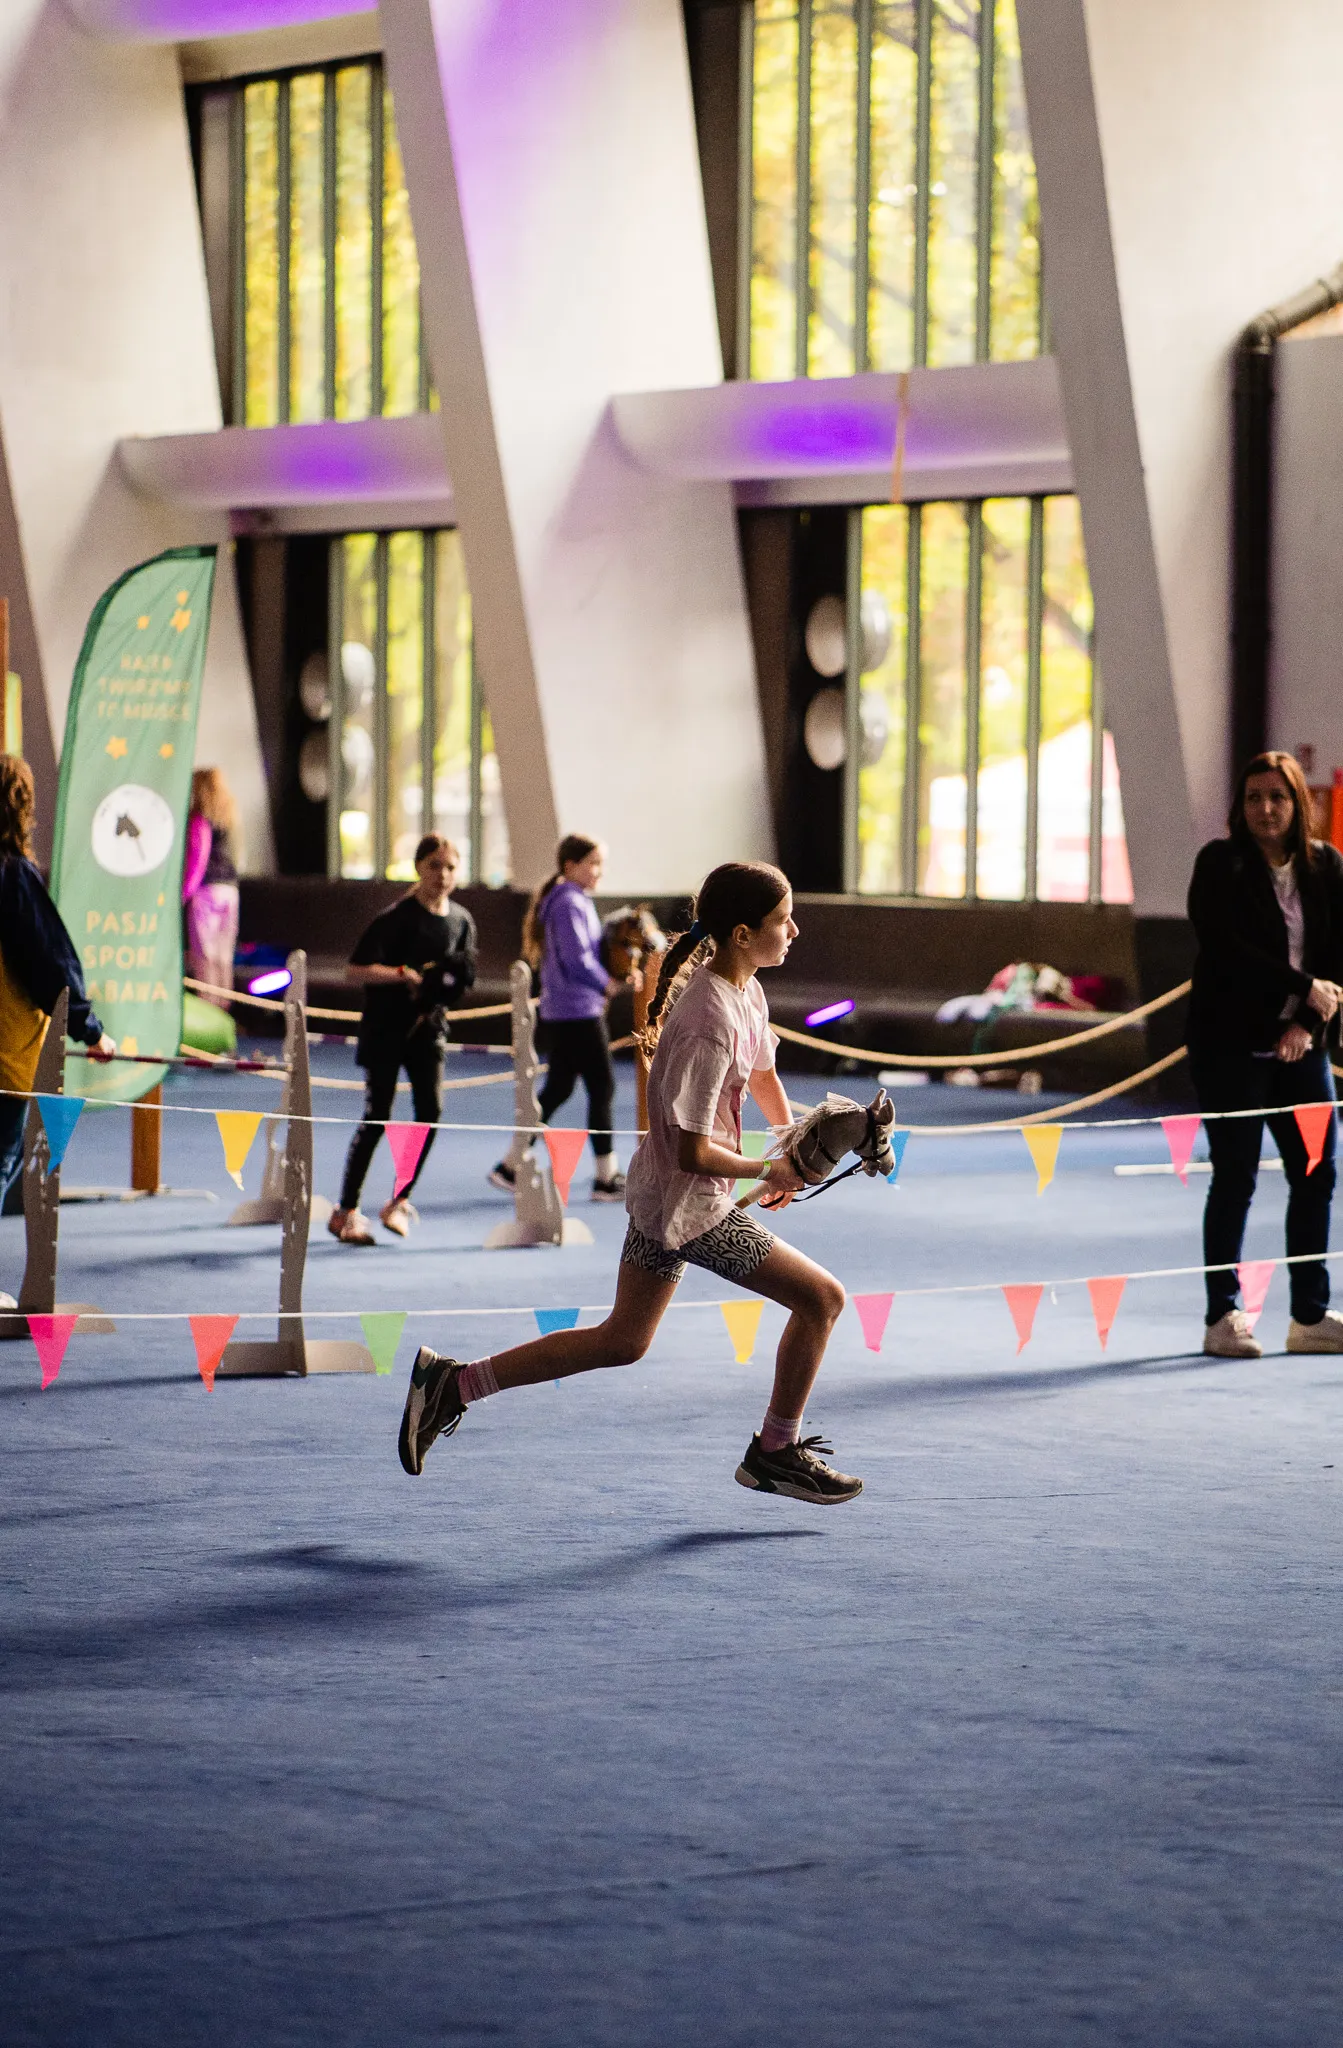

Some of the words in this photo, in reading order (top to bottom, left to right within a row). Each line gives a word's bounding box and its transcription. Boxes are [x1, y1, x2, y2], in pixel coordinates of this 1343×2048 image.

[99, 678, 192, 697] TWORZMY
[86, 911, 157, 935] PASJA
[86, 979, 168, 1003] ABAWA
